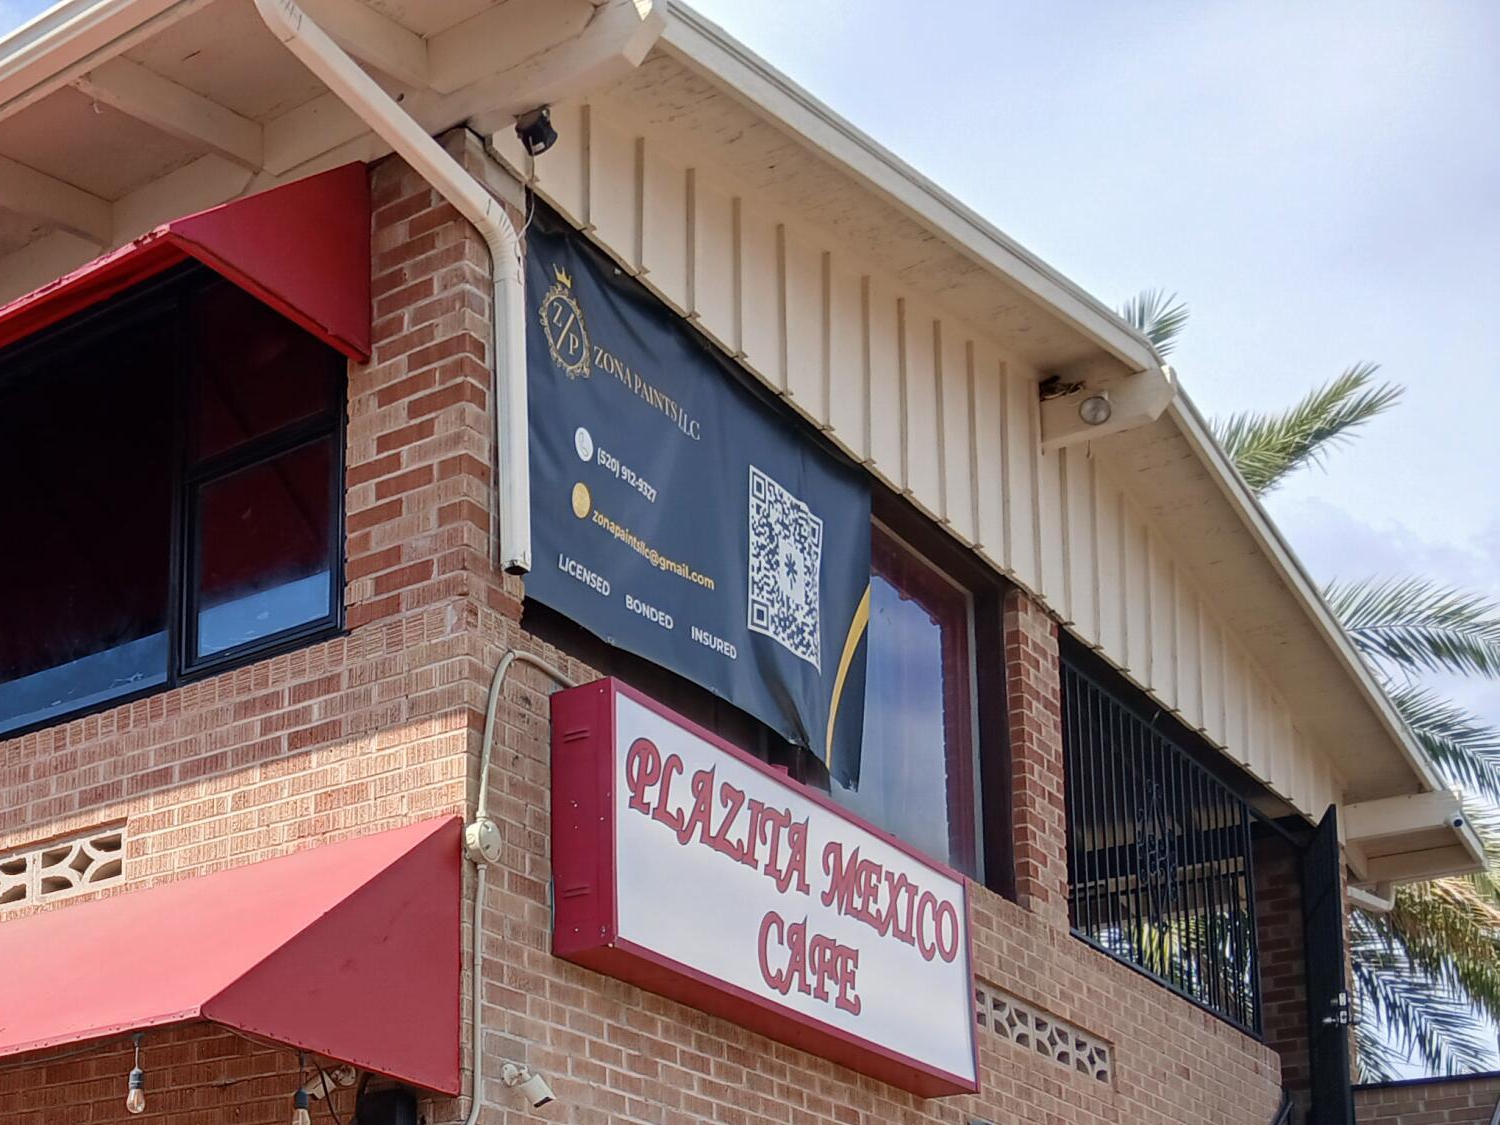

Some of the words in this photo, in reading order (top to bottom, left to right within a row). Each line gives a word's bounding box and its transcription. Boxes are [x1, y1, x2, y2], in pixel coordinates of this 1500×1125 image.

[593, 346, 632, 389] ZONA
[634, 372, 678, 423] PAINTS
[677, 407, 700, 441] LLC
[597, 447, 620, 478] (520)
[620, 465, 657, 503] 912-9327
[592, 509, 715, 591] zonapaintsllc@gmail.com
[558, 553, 611, 596] LICENSED
[625, 594, 674, 630] BONDED
[691, 625, 737, 660] INSURED
[625, 737, 811, 896] PLAZITA
[821, 841, 960, 964] MEXICO
[757, 911, 862, 1017] CAFE
